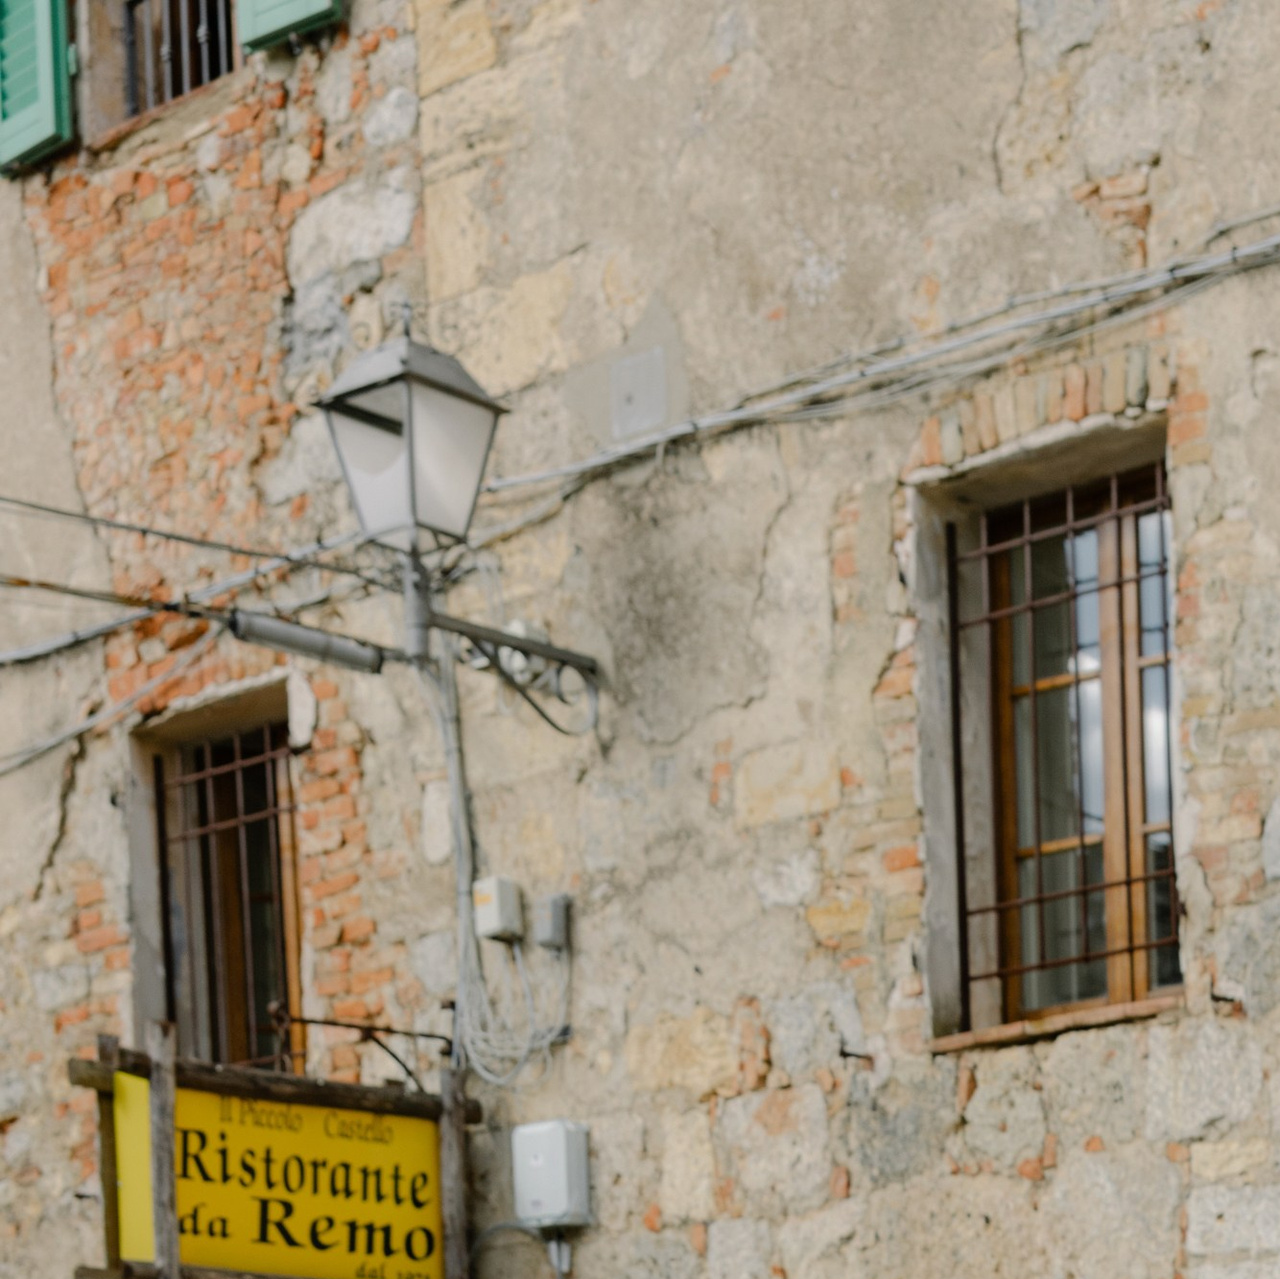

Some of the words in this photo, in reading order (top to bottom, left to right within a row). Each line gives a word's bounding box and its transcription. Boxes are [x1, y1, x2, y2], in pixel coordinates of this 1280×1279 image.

[239, 1099, 303, 1132] Piccolo
[323, 1110, 394, 1144] Castello
[176, 1127, 430, 1209] Ristorante
[178, 1203, 233, 1239] da
[251, 1196, 436, 1262] Remo
